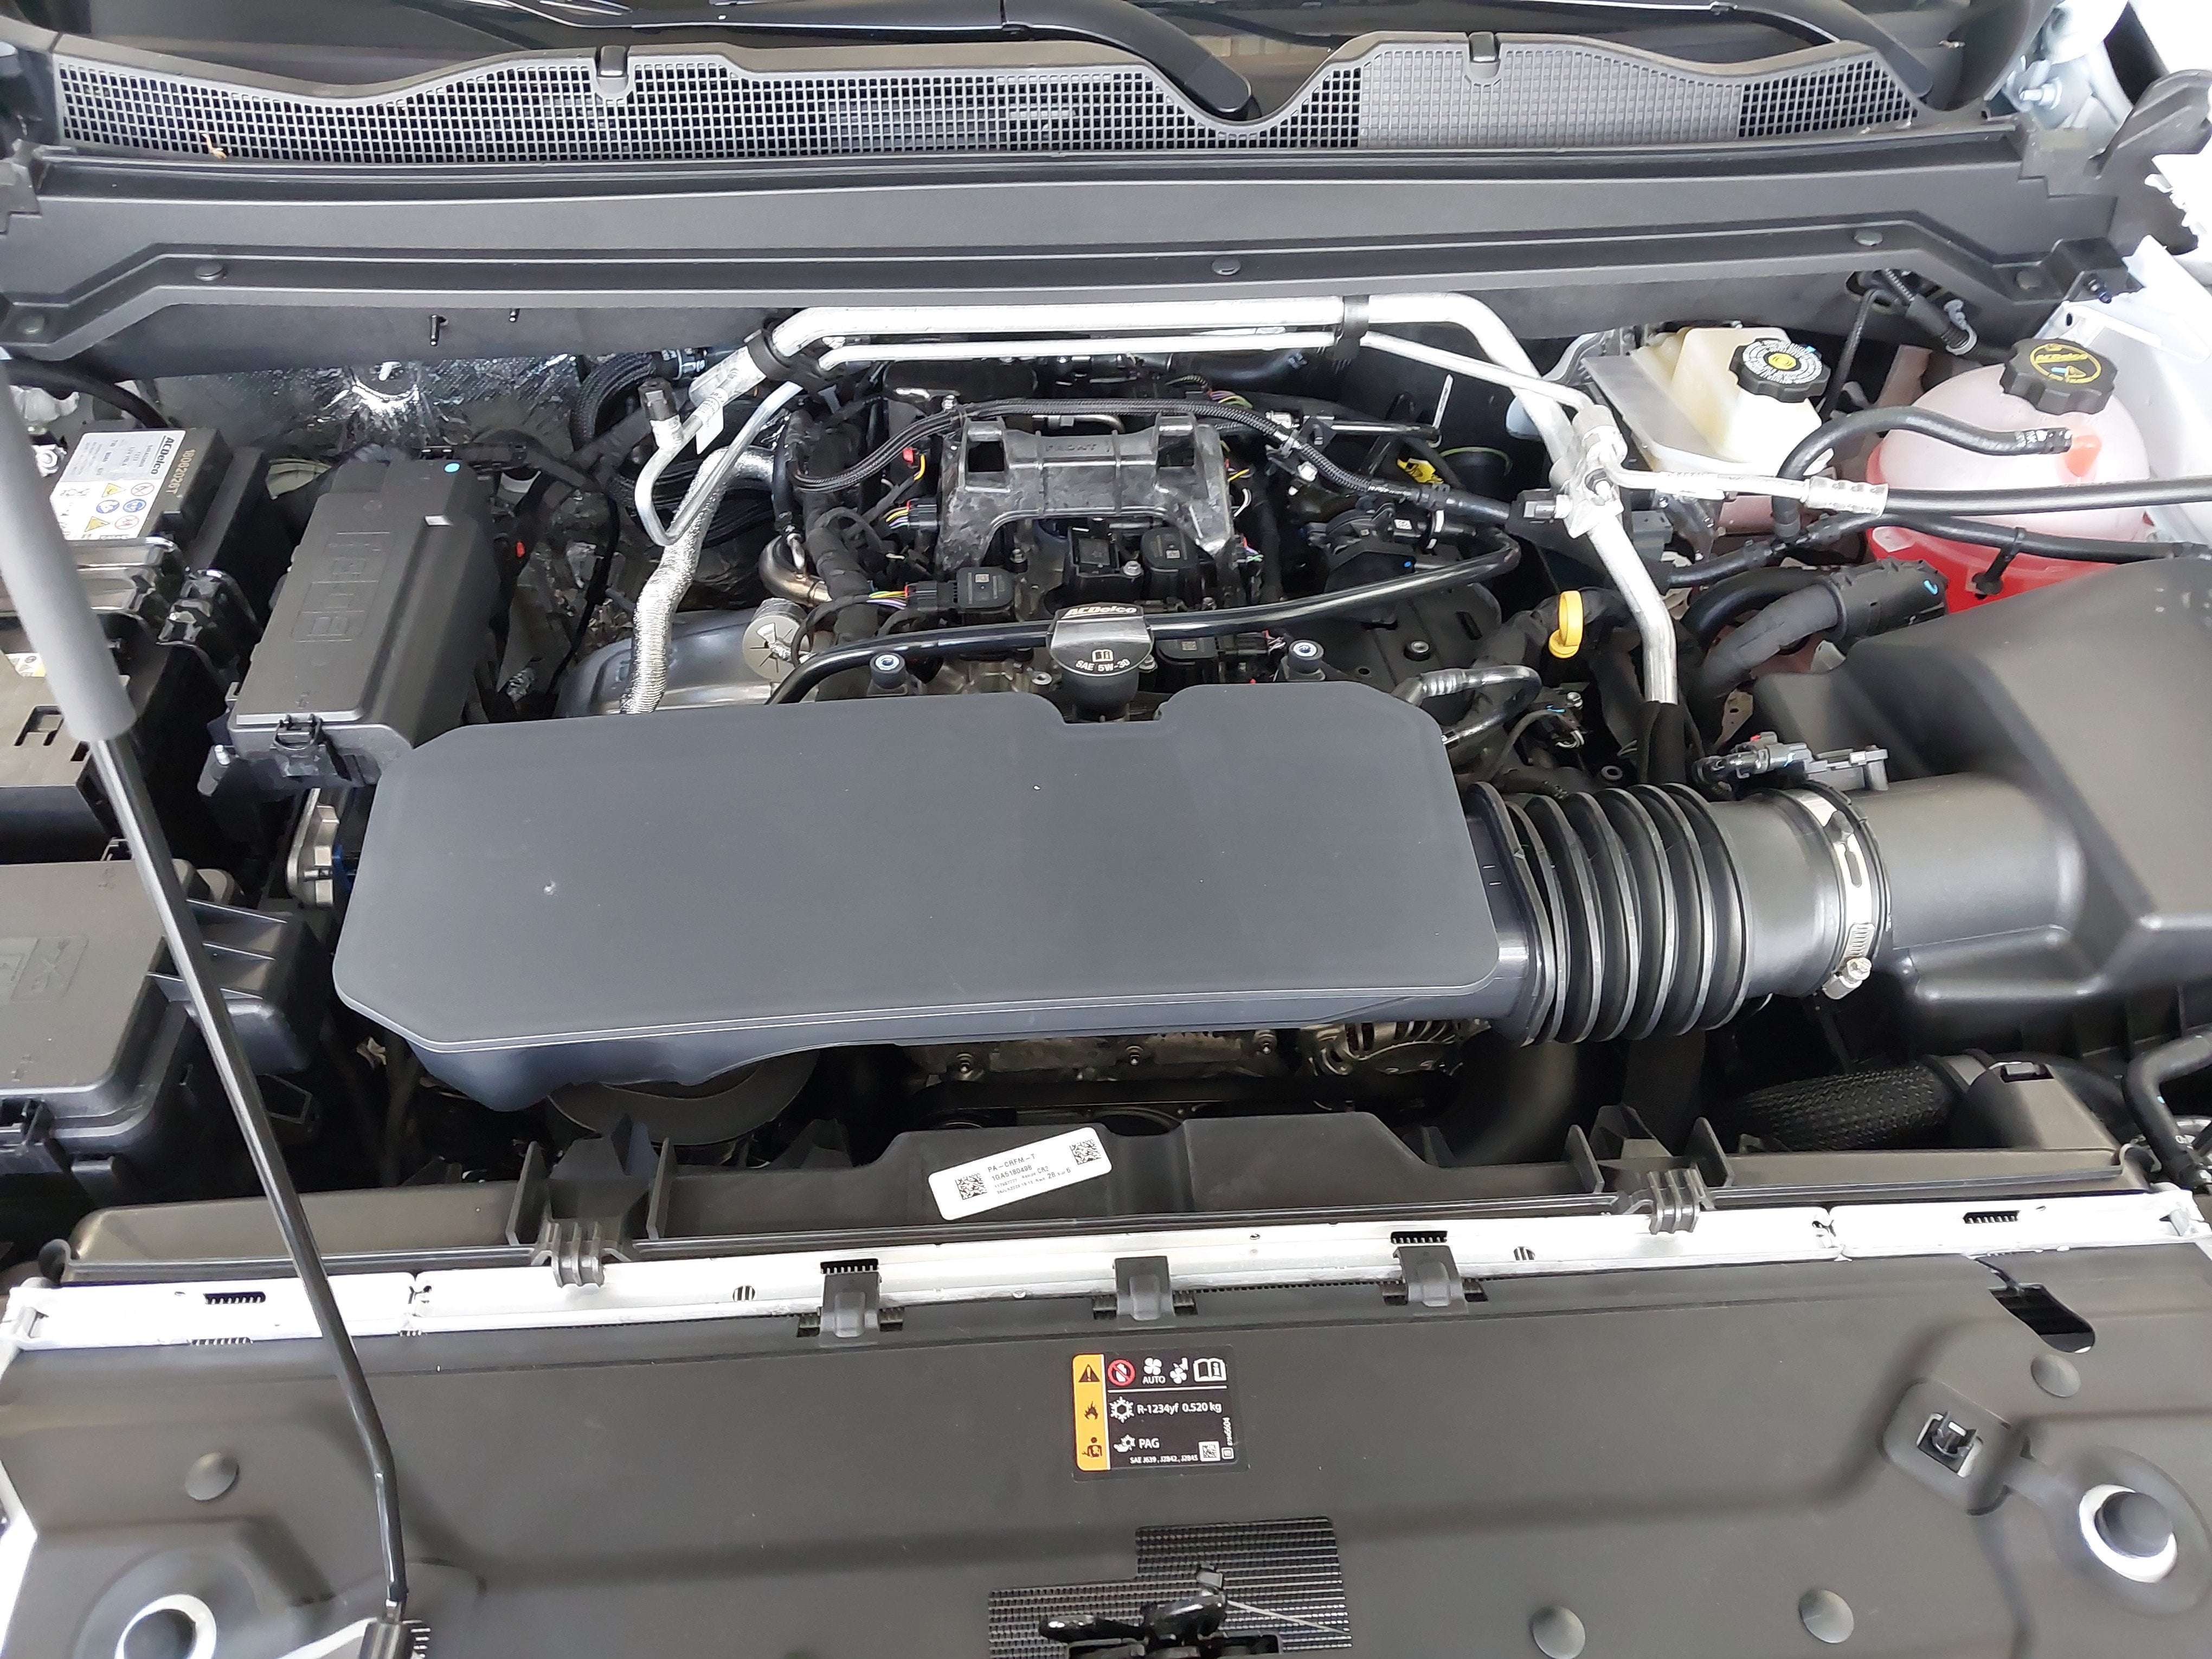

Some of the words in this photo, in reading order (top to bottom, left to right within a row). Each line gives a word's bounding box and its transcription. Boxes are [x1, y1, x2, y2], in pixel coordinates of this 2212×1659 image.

[150, 436, 175, 474] ACDelco
[1064, 606, 1137, 617] ACDelco
[1075, 660, 1095, 671] SAE
[1098, 659, 1130, 672] 5W-30
[1142, 1376, 1166, 1385] AUTO
[1137, 1402, 1179, 1415] R-1234yf
[1182, 1402, 1208, 1412] 0.520
[1209, 1401, 1222, 1413] kg
[1139, 1438, 1160, 1449] PAG
